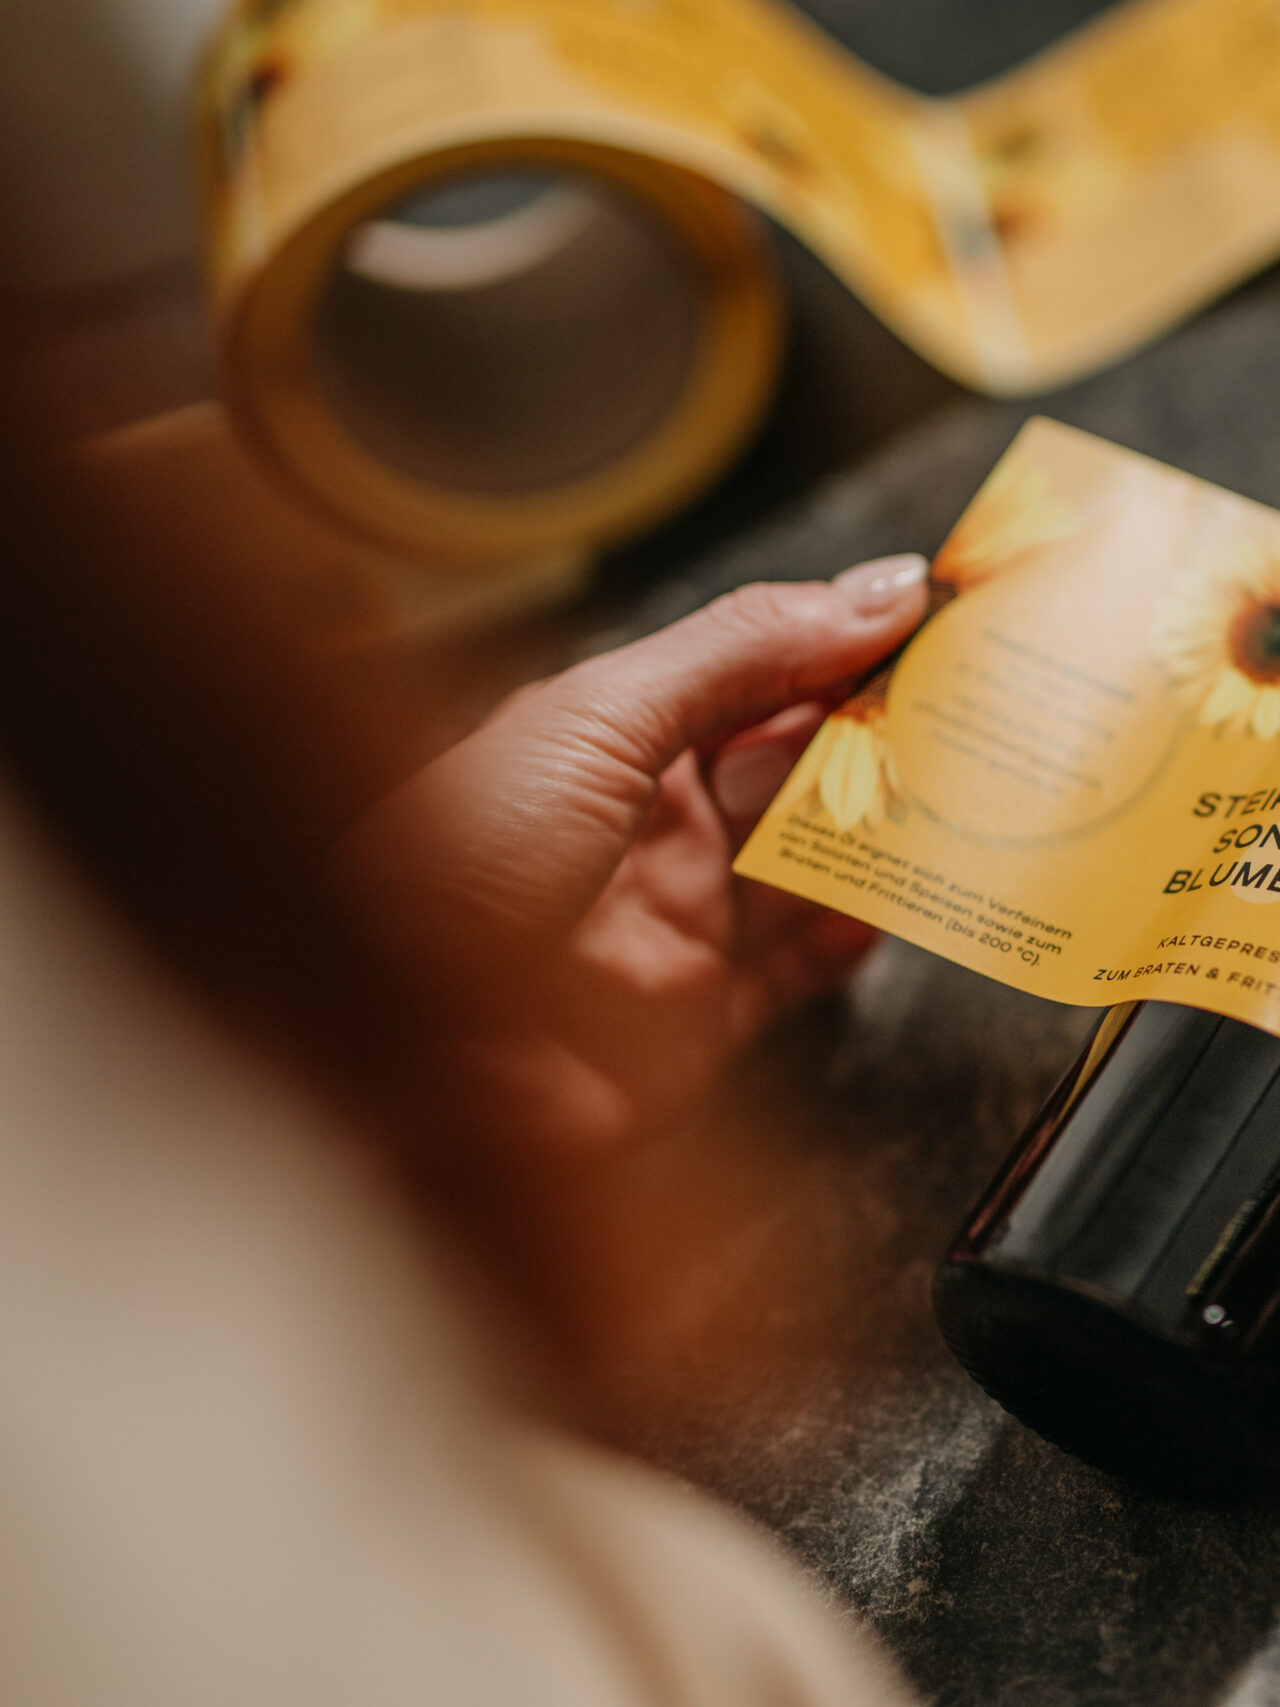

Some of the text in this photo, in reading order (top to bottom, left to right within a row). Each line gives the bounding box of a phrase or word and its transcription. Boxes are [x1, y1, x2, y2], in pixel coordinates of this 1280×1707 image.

[779, 847, 831, 875] Braten
[835, 870, 868, 890] und
[867, 881, 944, 924] Frittieren
[945, 918, 976, 938] (bis
[979, 932, 1012, 954] 200
[858, 842, 910, 870] eignet
[912, 864, 945, 885] sich
[949, 882, 984, 903] zum
[989, 897, 1073, 941] Verfeinern
[874, 865, 907, 888] und
[909, 881, 973, 918] Speisen
[977, 913, 1023, 941] sowie
[1026, 934, 1063, 955] zum
[1092, 968, 1132, 982] ZUM
[1133, 961, 1202, 980] BRATEN
[1205, 967, 1220, 982] &
